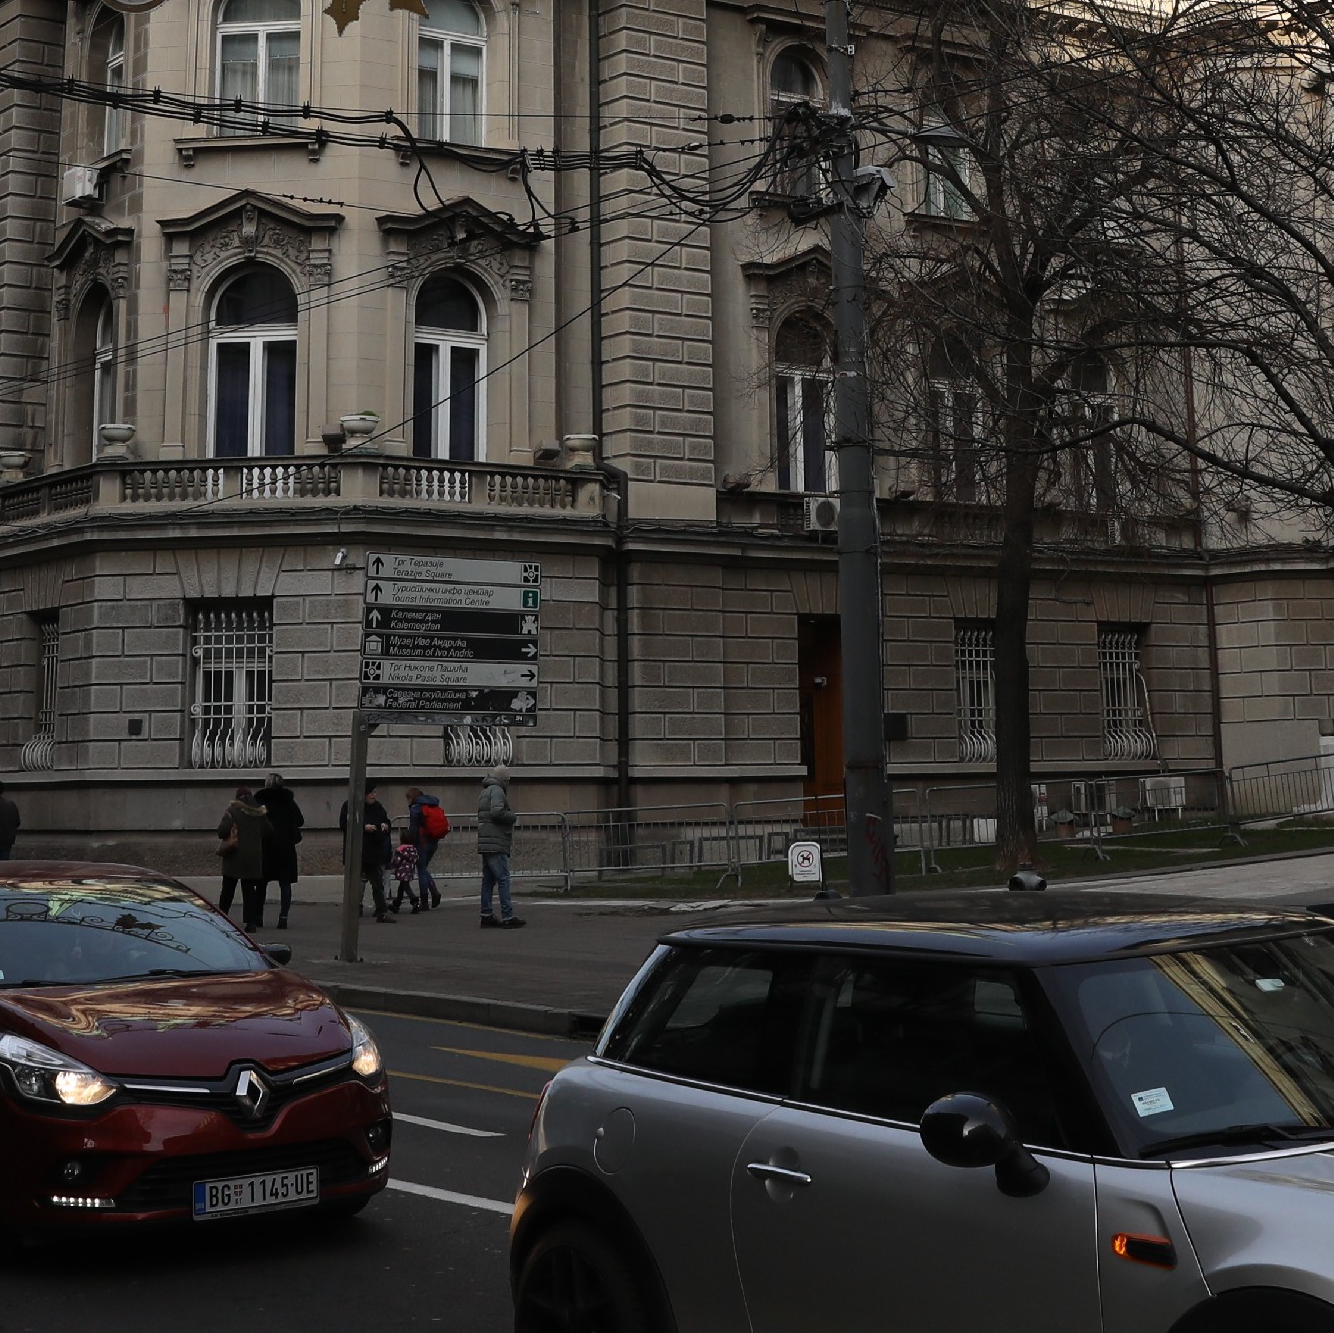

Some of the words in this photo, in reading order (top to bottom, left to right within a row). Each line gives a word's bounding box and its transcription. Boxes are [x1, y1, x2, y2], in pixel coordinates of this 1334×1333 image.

[409, 558, 444, 570] Теразије
[392, 568, 423, 578] Terazije
[425, 569, 453, 580] Square
[391, 594, 418, 604] Tourist
[419, 595, 463, 605] Information
[464, 597, 491, 606] Centre
[390, 610, 442, 621] Калемегдан
[390, 620, 441, 632] Kalemegdan
[390, 636, 414, 647] Музеј
[389, 647, 424, 656] Museum
[426, 647, 435, 656] of
[435, 648, 448, 657] Ivo
[388, 672, 413, 682] Nikola
[415, 673, 437, 683] Pasic
[439, 674, 468, 684] Square
[386, 700, 418, 710] Federal
[419, 701, 462, 710] Parliament
[209, 1184, 231, 1208] BG
